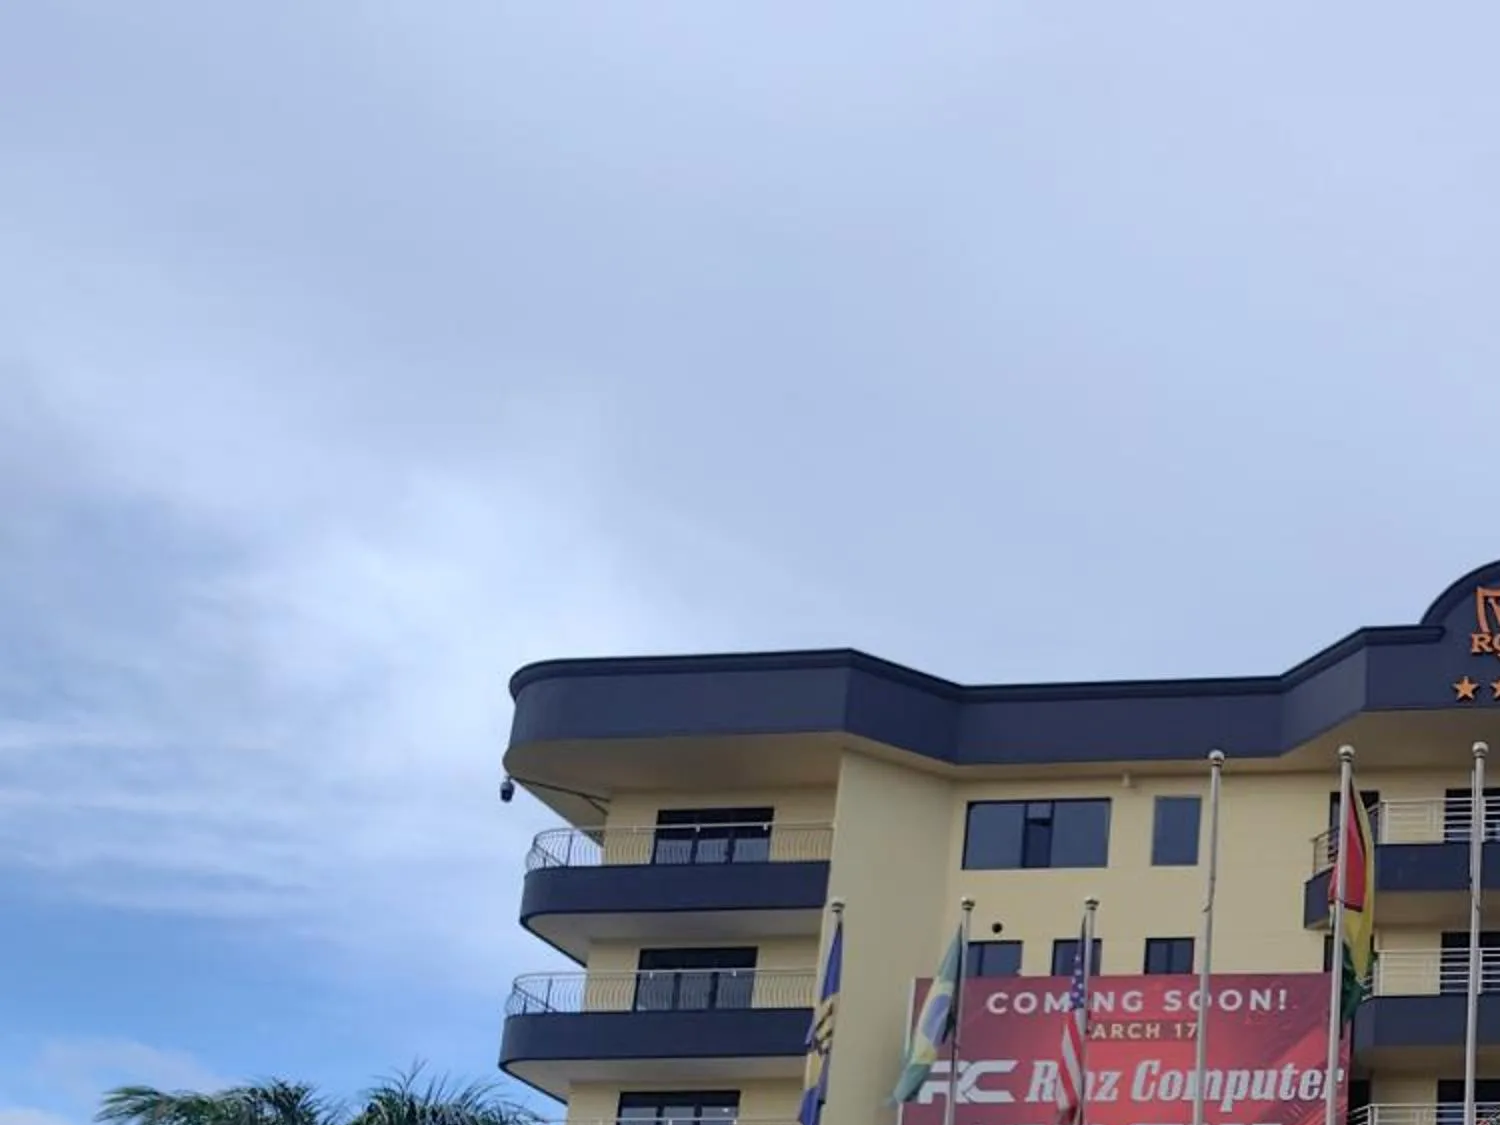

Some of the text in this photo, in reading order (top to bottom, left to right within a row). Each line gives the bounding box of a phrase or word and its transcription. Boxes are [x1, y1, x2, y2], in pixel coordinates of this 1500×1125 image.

[987, 988, 1288, 1014] COMNG SOON!
[1086, 1020, 1198, 1040] ARCH 17
[1024, 1059, 1345, 1113] Rz Computer
